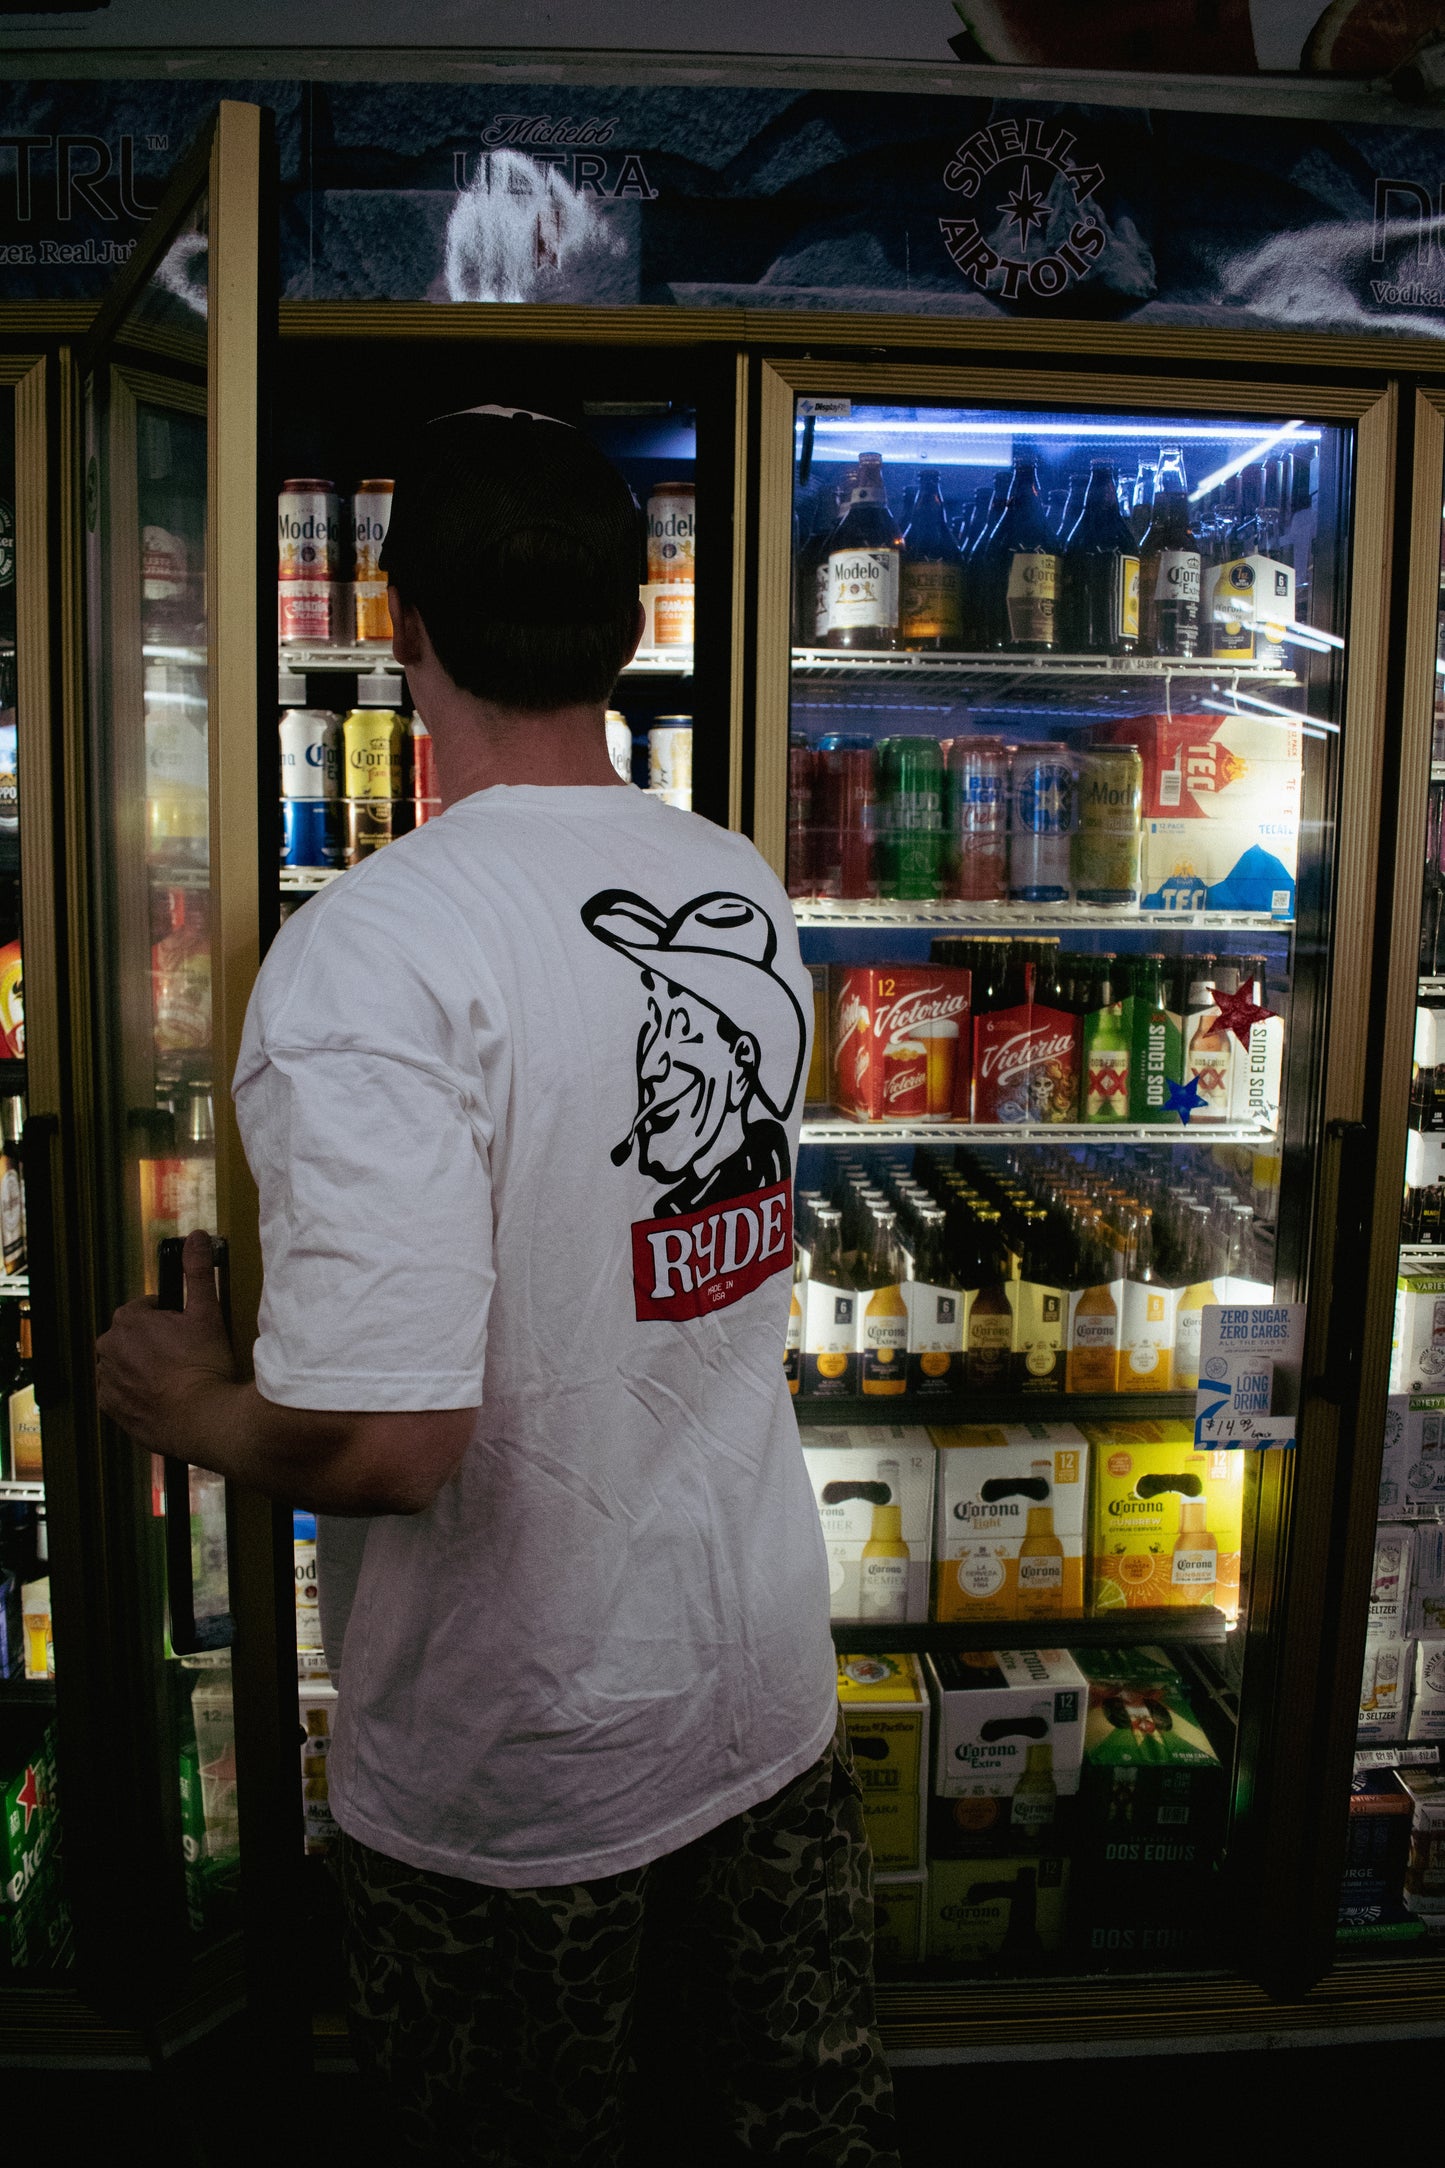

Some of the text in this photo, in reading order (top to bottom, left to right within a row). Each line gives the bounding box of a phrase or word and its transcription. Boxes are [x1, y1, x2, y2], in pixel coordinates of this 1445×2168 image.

[481, 114, 620, 146] Michelob
[943, 118, 1106, 206] STELLA
[40, 239, 95, 265] Real
[938, 217, 1106, 300] ARTOIS
[835, 563, 880, 580] Modelo
[878, 979, 896, 997] 12
[873, 983, 969, 1044] Victoria
[986, 1020, 995, 1032] 6
[981, 1023, 1076, 1086] Victoria
[1250, 1028, 1267, 1074] EQUIS
[1147, 1024, 1166, 1106] DOS EQUIS
[707, 1280, 734, 1295] MADE IN
[712, 1291, 726, 1302] USA
[840, 1302, 847, 1314] 6
[943, 1301, 950, 1313] 6
[1220, 1309, 1291, 1324] ZERO SUGAR.
[1219, 1325, 1290, 1339] ZERO CARBS.
[1236, 1376, 1269, 1393] LONG
[1233, 1393, 1270, 1411] DRINK
[911, 1457, 923, 1468] 12
[1060, 1453, 1074, 1469] 12
[1213, 1451, 1227, 1467] 12
[953, 1500, 1020, 1523] Corona
[1108, 1499, 1164, 1519] Corona
[973, 1517, 1001, 1530] Light
[1021, 1565, 1060, 1579] Corona
[1177, 1559, 1213, 1571] Corona
[1060, 1694, 1073, 1709] 12
[1366, 1711, 1396, 1720] SELTZER
[955, 1743, 1017, 1762] Corona
[971, 1759, 1001, 1769] Extra
[1104, 1843, 1196, 1862] DOS EQUIS
[940, 1905, 1000, 1921] Corona
[1091, 1928, 1135, 1950] DOS
